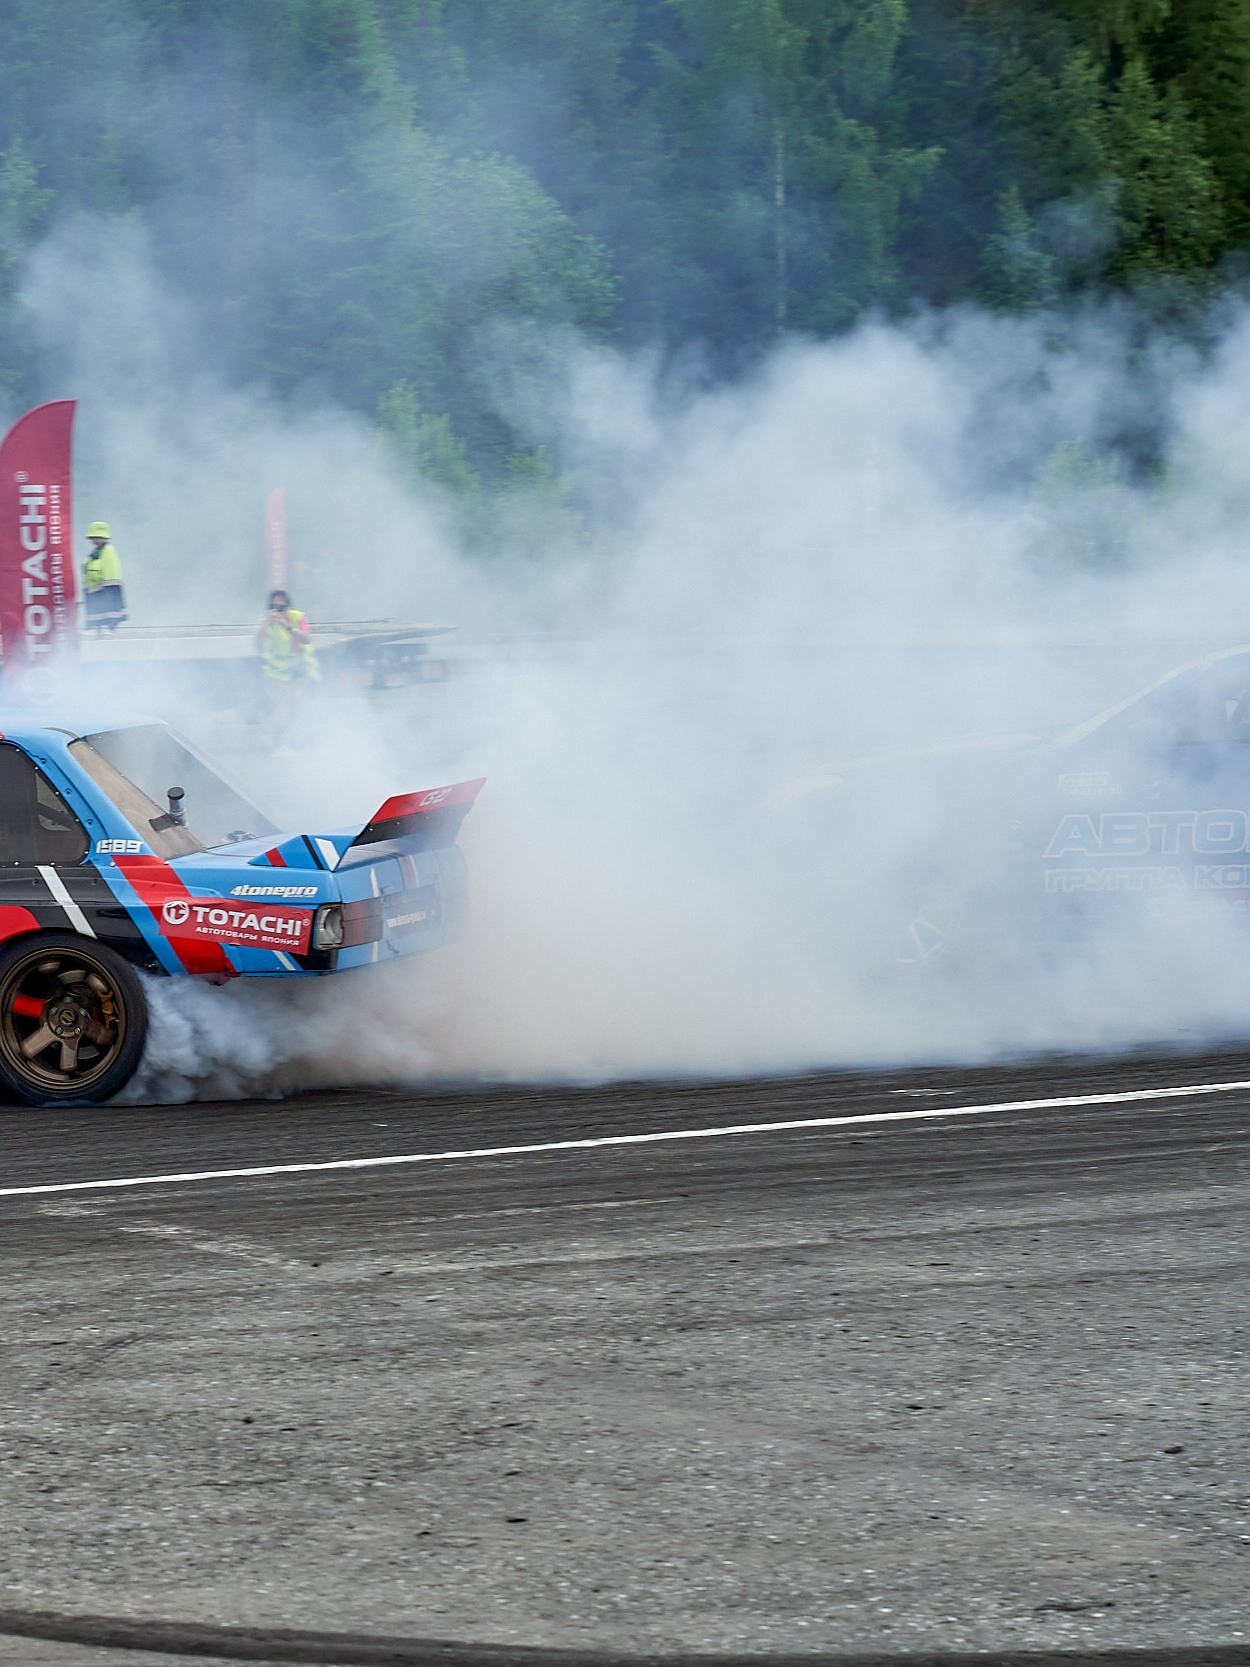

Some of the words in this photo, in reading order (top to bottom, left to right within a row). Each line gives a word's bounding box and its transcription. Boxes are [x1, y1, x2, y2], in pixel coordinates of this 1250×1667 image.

[1041, 809, 1250, 858] АВТО
[1194, 864, 1250, 889] КО
[192, 906, 301, 936] TOTACHI
[195, 926, 258, 941] АВТОТОВАРЫ
[260, 935, 300, 946] ЯПОНИЯ
